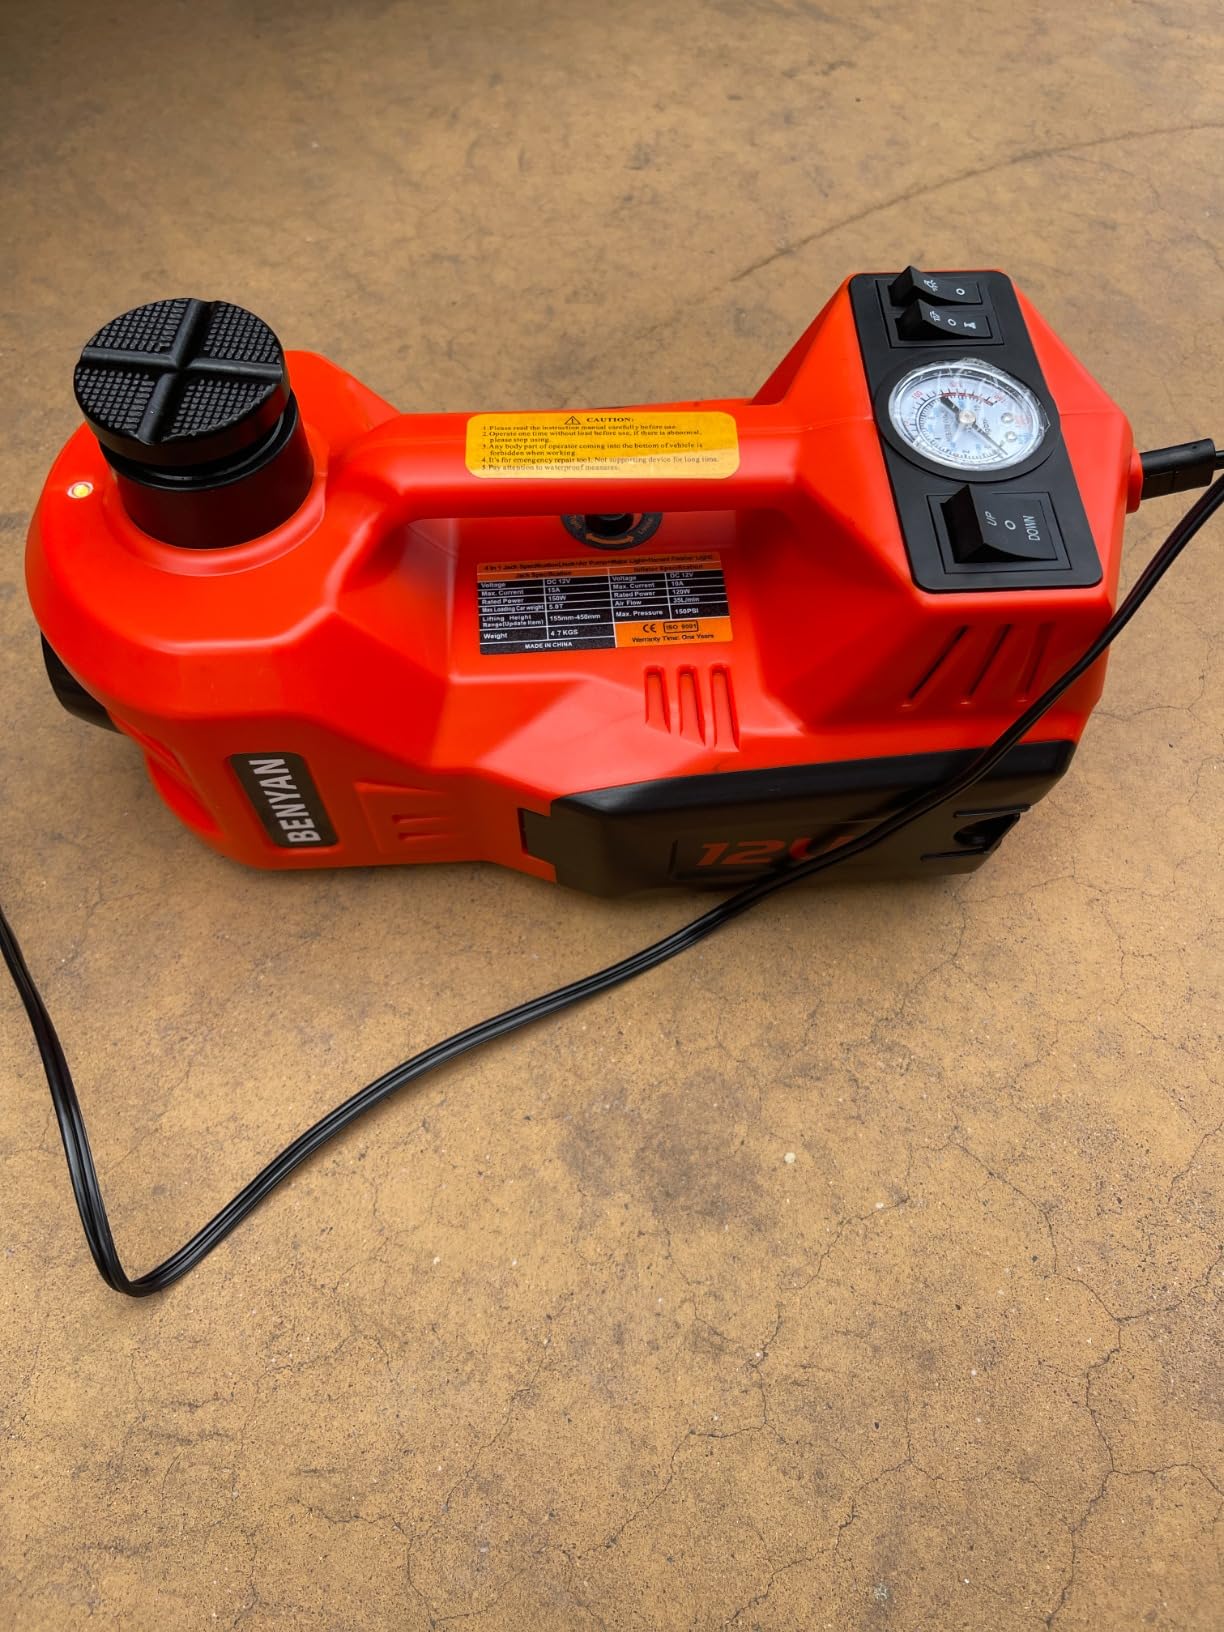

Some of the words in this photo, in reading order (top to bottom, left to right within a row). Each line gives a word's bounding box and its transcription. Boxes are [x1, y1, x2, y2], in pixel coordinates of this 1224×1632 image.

[547, 463, 584, 471] waterproof
[985, 511, 998, 527] UP
[1023, 515, 1041, 541] DOWN
[483, 632, 508, 640] Weight
[632, 635, 660, 643] Warranty
[248, 758, 321, 842] BENYAN
